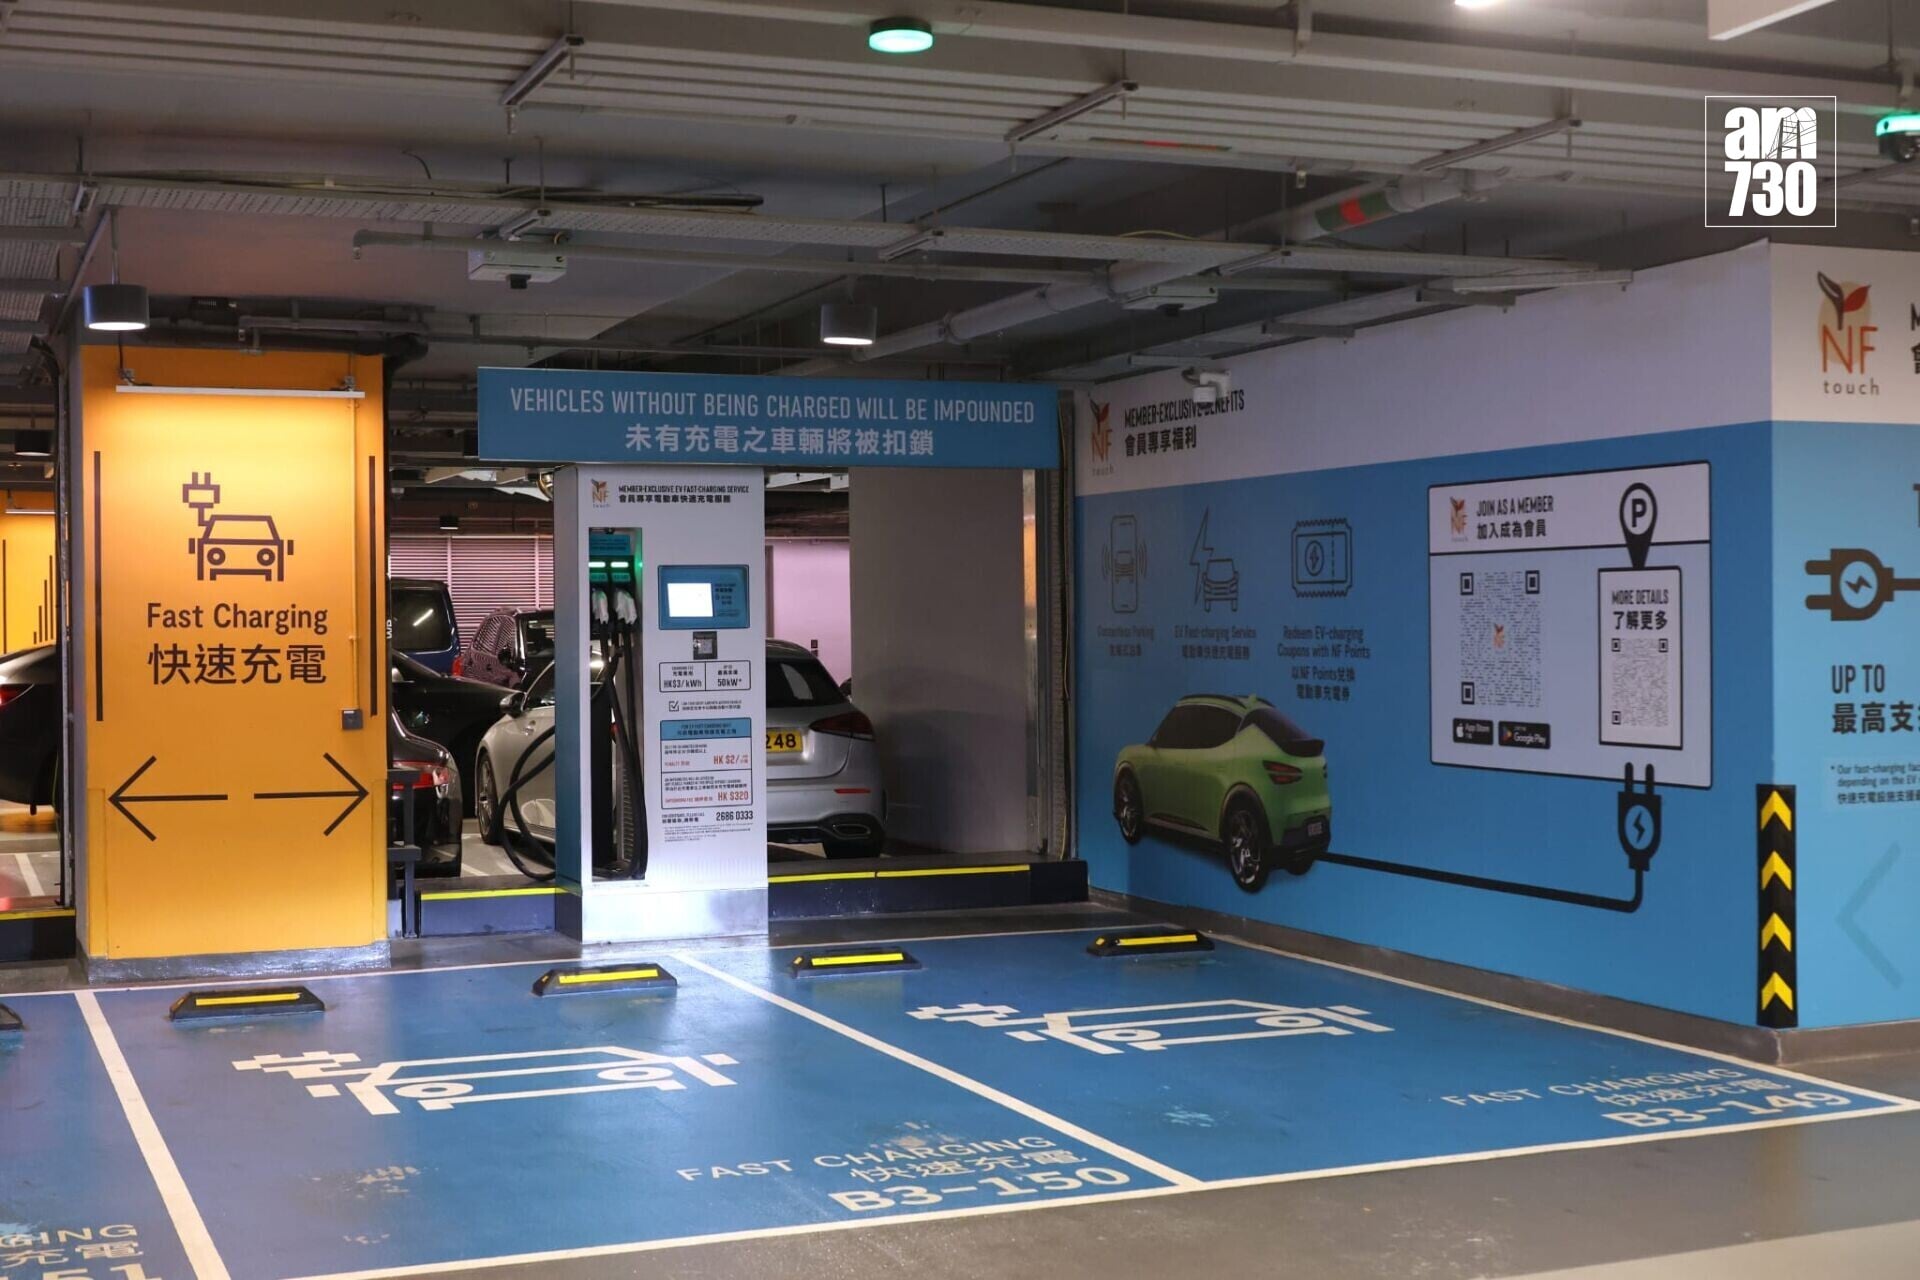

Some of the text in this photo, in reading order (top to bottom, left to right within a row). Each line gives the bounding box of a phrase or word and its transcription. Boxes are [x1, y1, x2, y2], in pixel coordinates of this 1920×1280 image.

[1821, 324, 1878, 374] NF
[1823, 378, 1879, 395] touch
[510, 388, 1035, 424] VEHICLES WITHOUT BEING CHARGED WILL BE IMPOUNDED
[625, 423, 935, 456] 未有充電之車輛將被扣鎖
[1091, 429, 1113, 463] NF
[1124, 424, 1197, 457] 會員專享福利
[1476, 495, 1554, 517] JOIN AS A MEMBER
[1631, 498, 1647, 528] P
[1476, 518, 1547, 540] 加入成為會員
[1611, 589, 1669, 606] MORE DETAILS
[147, 602, 328, 635] Fast Charging
[1612, 610, 1668, 631] 了解更多
[147, 643, 327, 685] 快速充電
[1312, 643, 1329, 657] with
[1344, 644, 1371, 659] Points
[1831, 664, 1886, 694] UP TO
[1831, 700, 1920, 735] 最高支
[1441, 1067, 1748, 1107] FAST CHARGING
[1593, 1077, 1791, 1109] 快速充電
[1601, 1091, 1852, 1128] B3-149
[677, 1135, 1057, 1182] FAST CHARGING
[849, 1149, 1088, 1184] 快速充電
[827, 1165, 1132, 1212] B3-150
